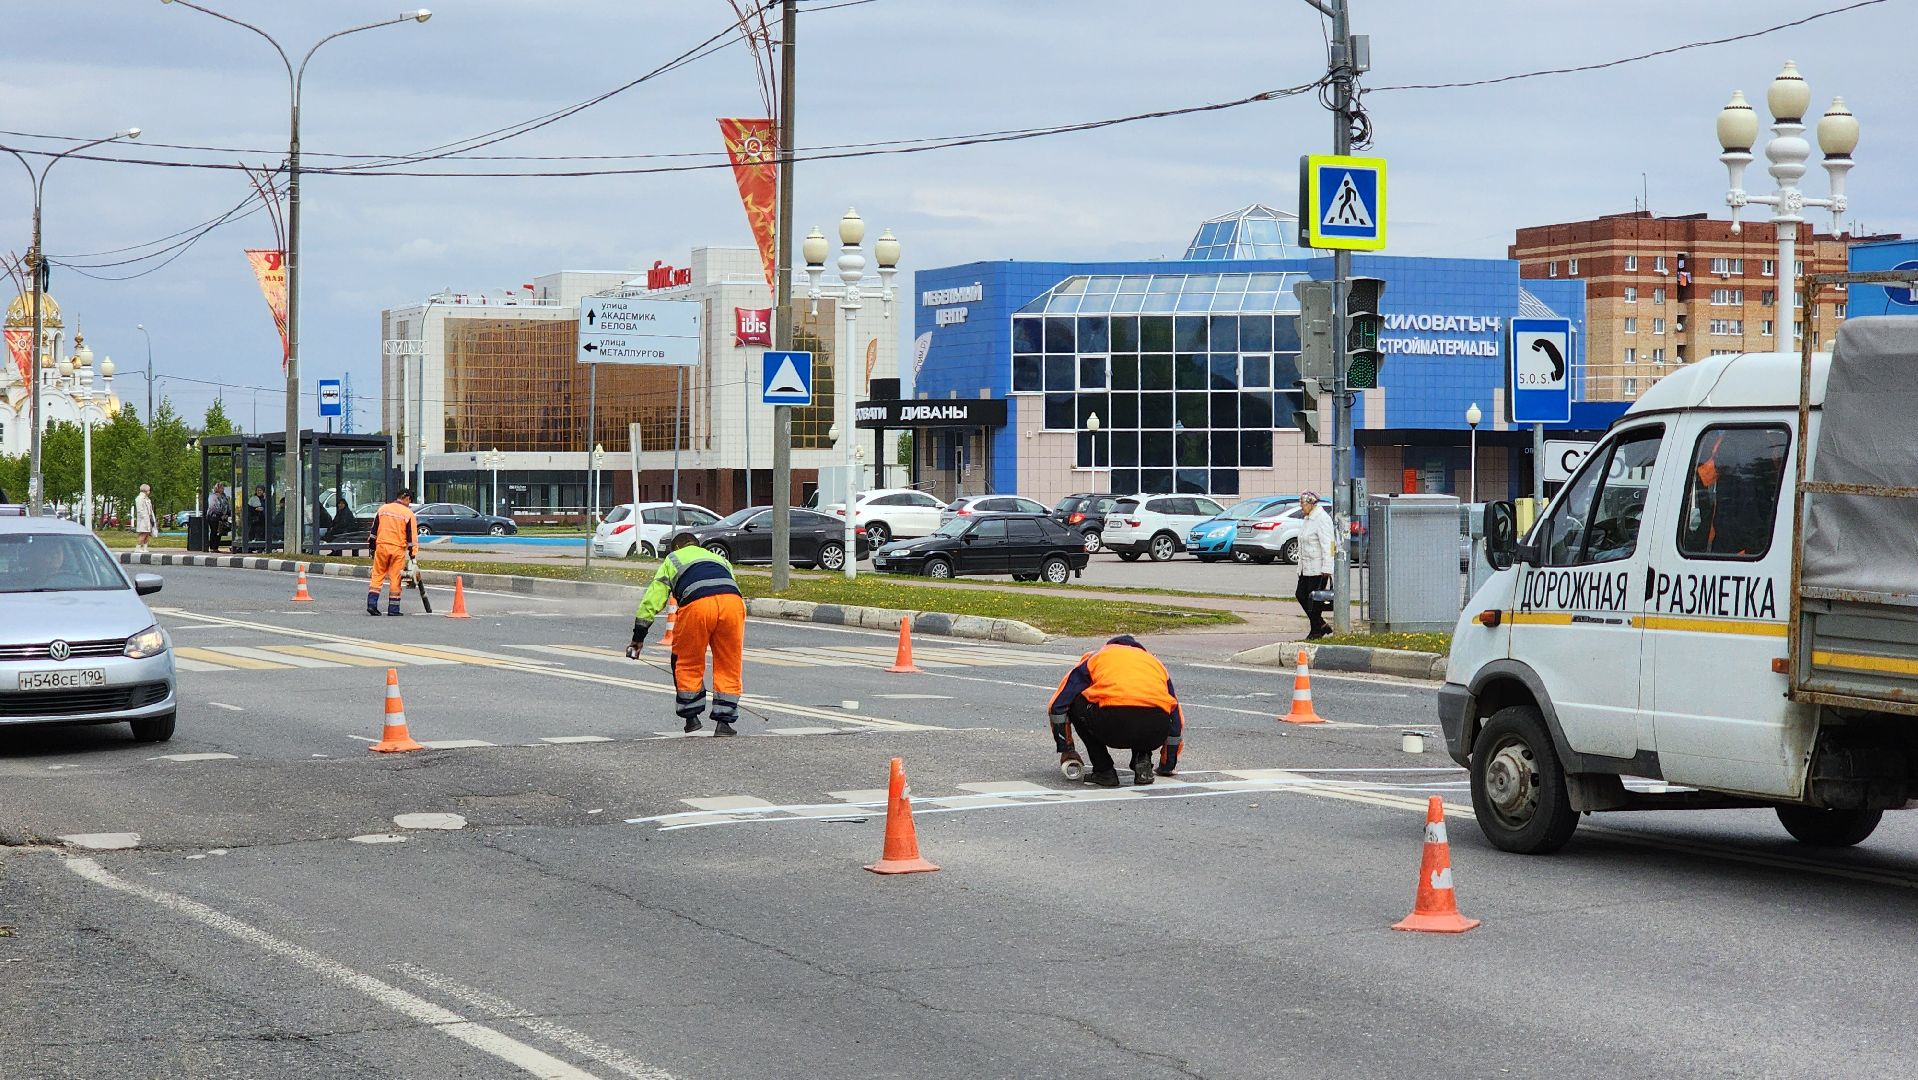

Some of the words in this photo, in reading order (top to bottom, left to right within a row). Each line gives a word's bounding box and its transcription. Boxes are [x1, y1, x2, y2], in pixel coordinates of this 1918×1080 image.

[264, 253, 281, 270] 9
[922, 281, 983, 306] МЕБЕЛЬНЫЙ
[600, 312, 656, 321] АКАДЕМИКА
[935, 307, 969, 328] ЦЕНТР
[600, 322, 638, 331] БЕЛОВА
[741, 317, 767, 333] ibis
[599, 348, 665, 358] МЕТАЛЛУРГОВ
[1378, 336, 1499, 357] СТРОЙМАТЕРИАЛЫ
[1519, 373, 1550, 385] S.O.S.
[900, 405, 968, 421] ДИВАНЫ
[1520, 570, 1629, 614] ДОРОЖНАЯ
[1656, 573, 1777, 619] РАЗМЕТКА
[81, 670, 101, 681] 190
